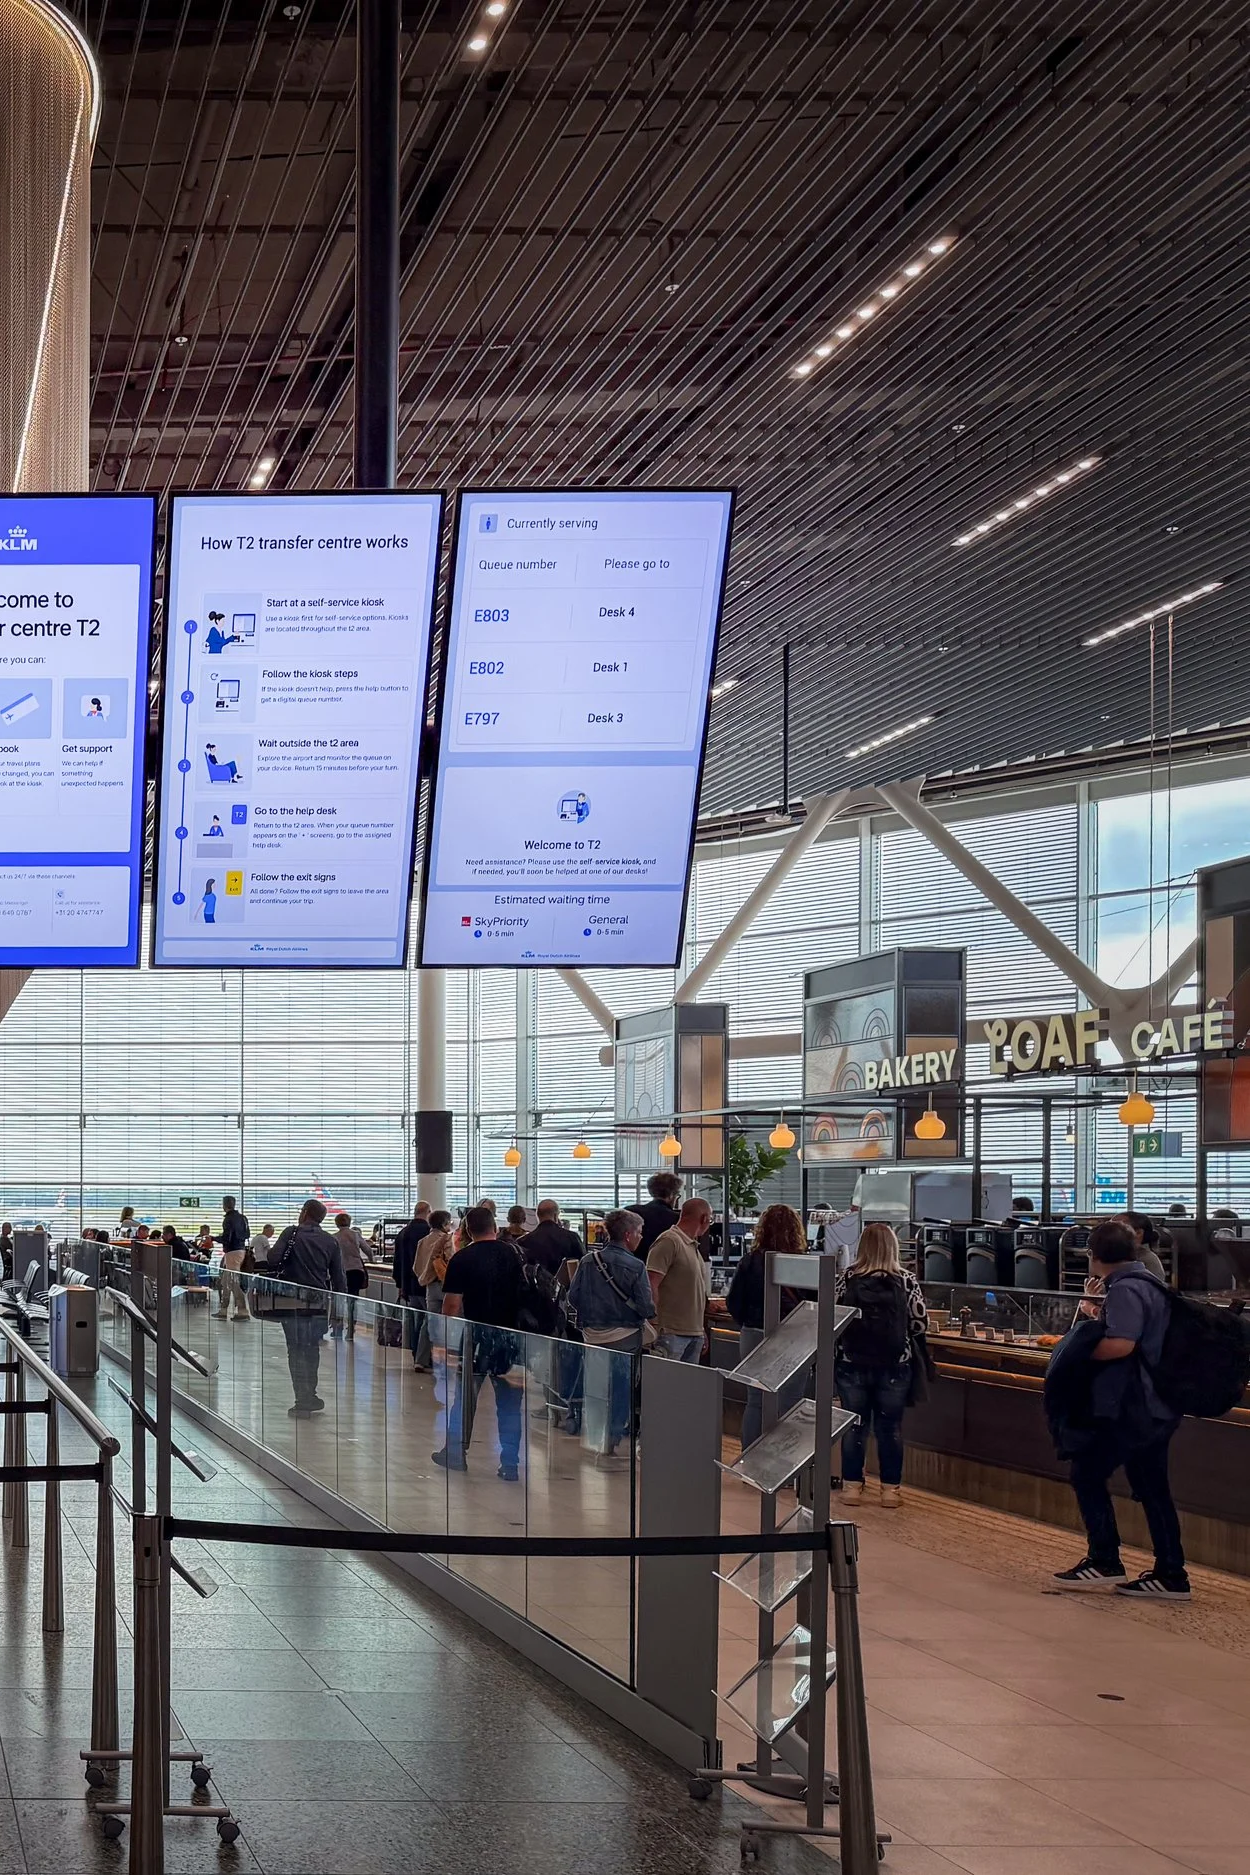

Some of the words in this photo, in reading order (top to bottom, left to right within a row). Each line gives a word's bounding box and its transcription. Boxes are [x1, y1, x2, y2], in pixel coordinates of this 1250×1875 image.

[508, 518, 556, 530] Currently
[559, 518, 598, 530] serving
[202, 537, 232, 550] How
[237, 536, 254, 549] T2
[259, 535, 314, 549] transfer
[318, 536, 361, 549] centre
[366, 534, 408, 548] works
[479, 560, 513, 570] Queue
[516, 559, 557, 569] number
[605, 559, 639, 568] Please
[643, 561, 656, 571] go
[660, 560, 669, 568] to
[54, 592, 73, 608] to
[267, 599, 287, 607] Start
[308, 598, 359, 606] self-service
[475, 609, 509, 622] E803
[600, 607, 625, 617] Desk
[628, 607, 634, 616] 4
[11, 620, 71, 636] centre
[77, 620, 100, 636] T2
[11, 657, 26, 665] you
[470, 662, 504, 674] E802
[594, 662, 619, 672] Desk
[624, 662, 627, 672] 1
[334, 670, 358, 679] steps
[465, 713, 500, 725] E797
[588, 713, 613, 722] Desk
[617, 713, 623, 722] 3
[80, 746, 112, 754] support
[296, 808, 314, 816] help
[525, 840, 571, 849] Welcome
[588, 840, 600, 849] T2
[314, 873, 336, 882] signs
[495, 896, 545, 904] Estimated
[548, 895, 584, 906] waiting
[588, 895, 610, 904] time
[475, 917, 529, 928] SkyPriority
[589, 916, 628, 924] General
[864, 1048, 956, 1091] BAKERY
[983, 1008, 1101, 1074] LOAF
[1131, 998, 1226, 1058] CAFÉ
